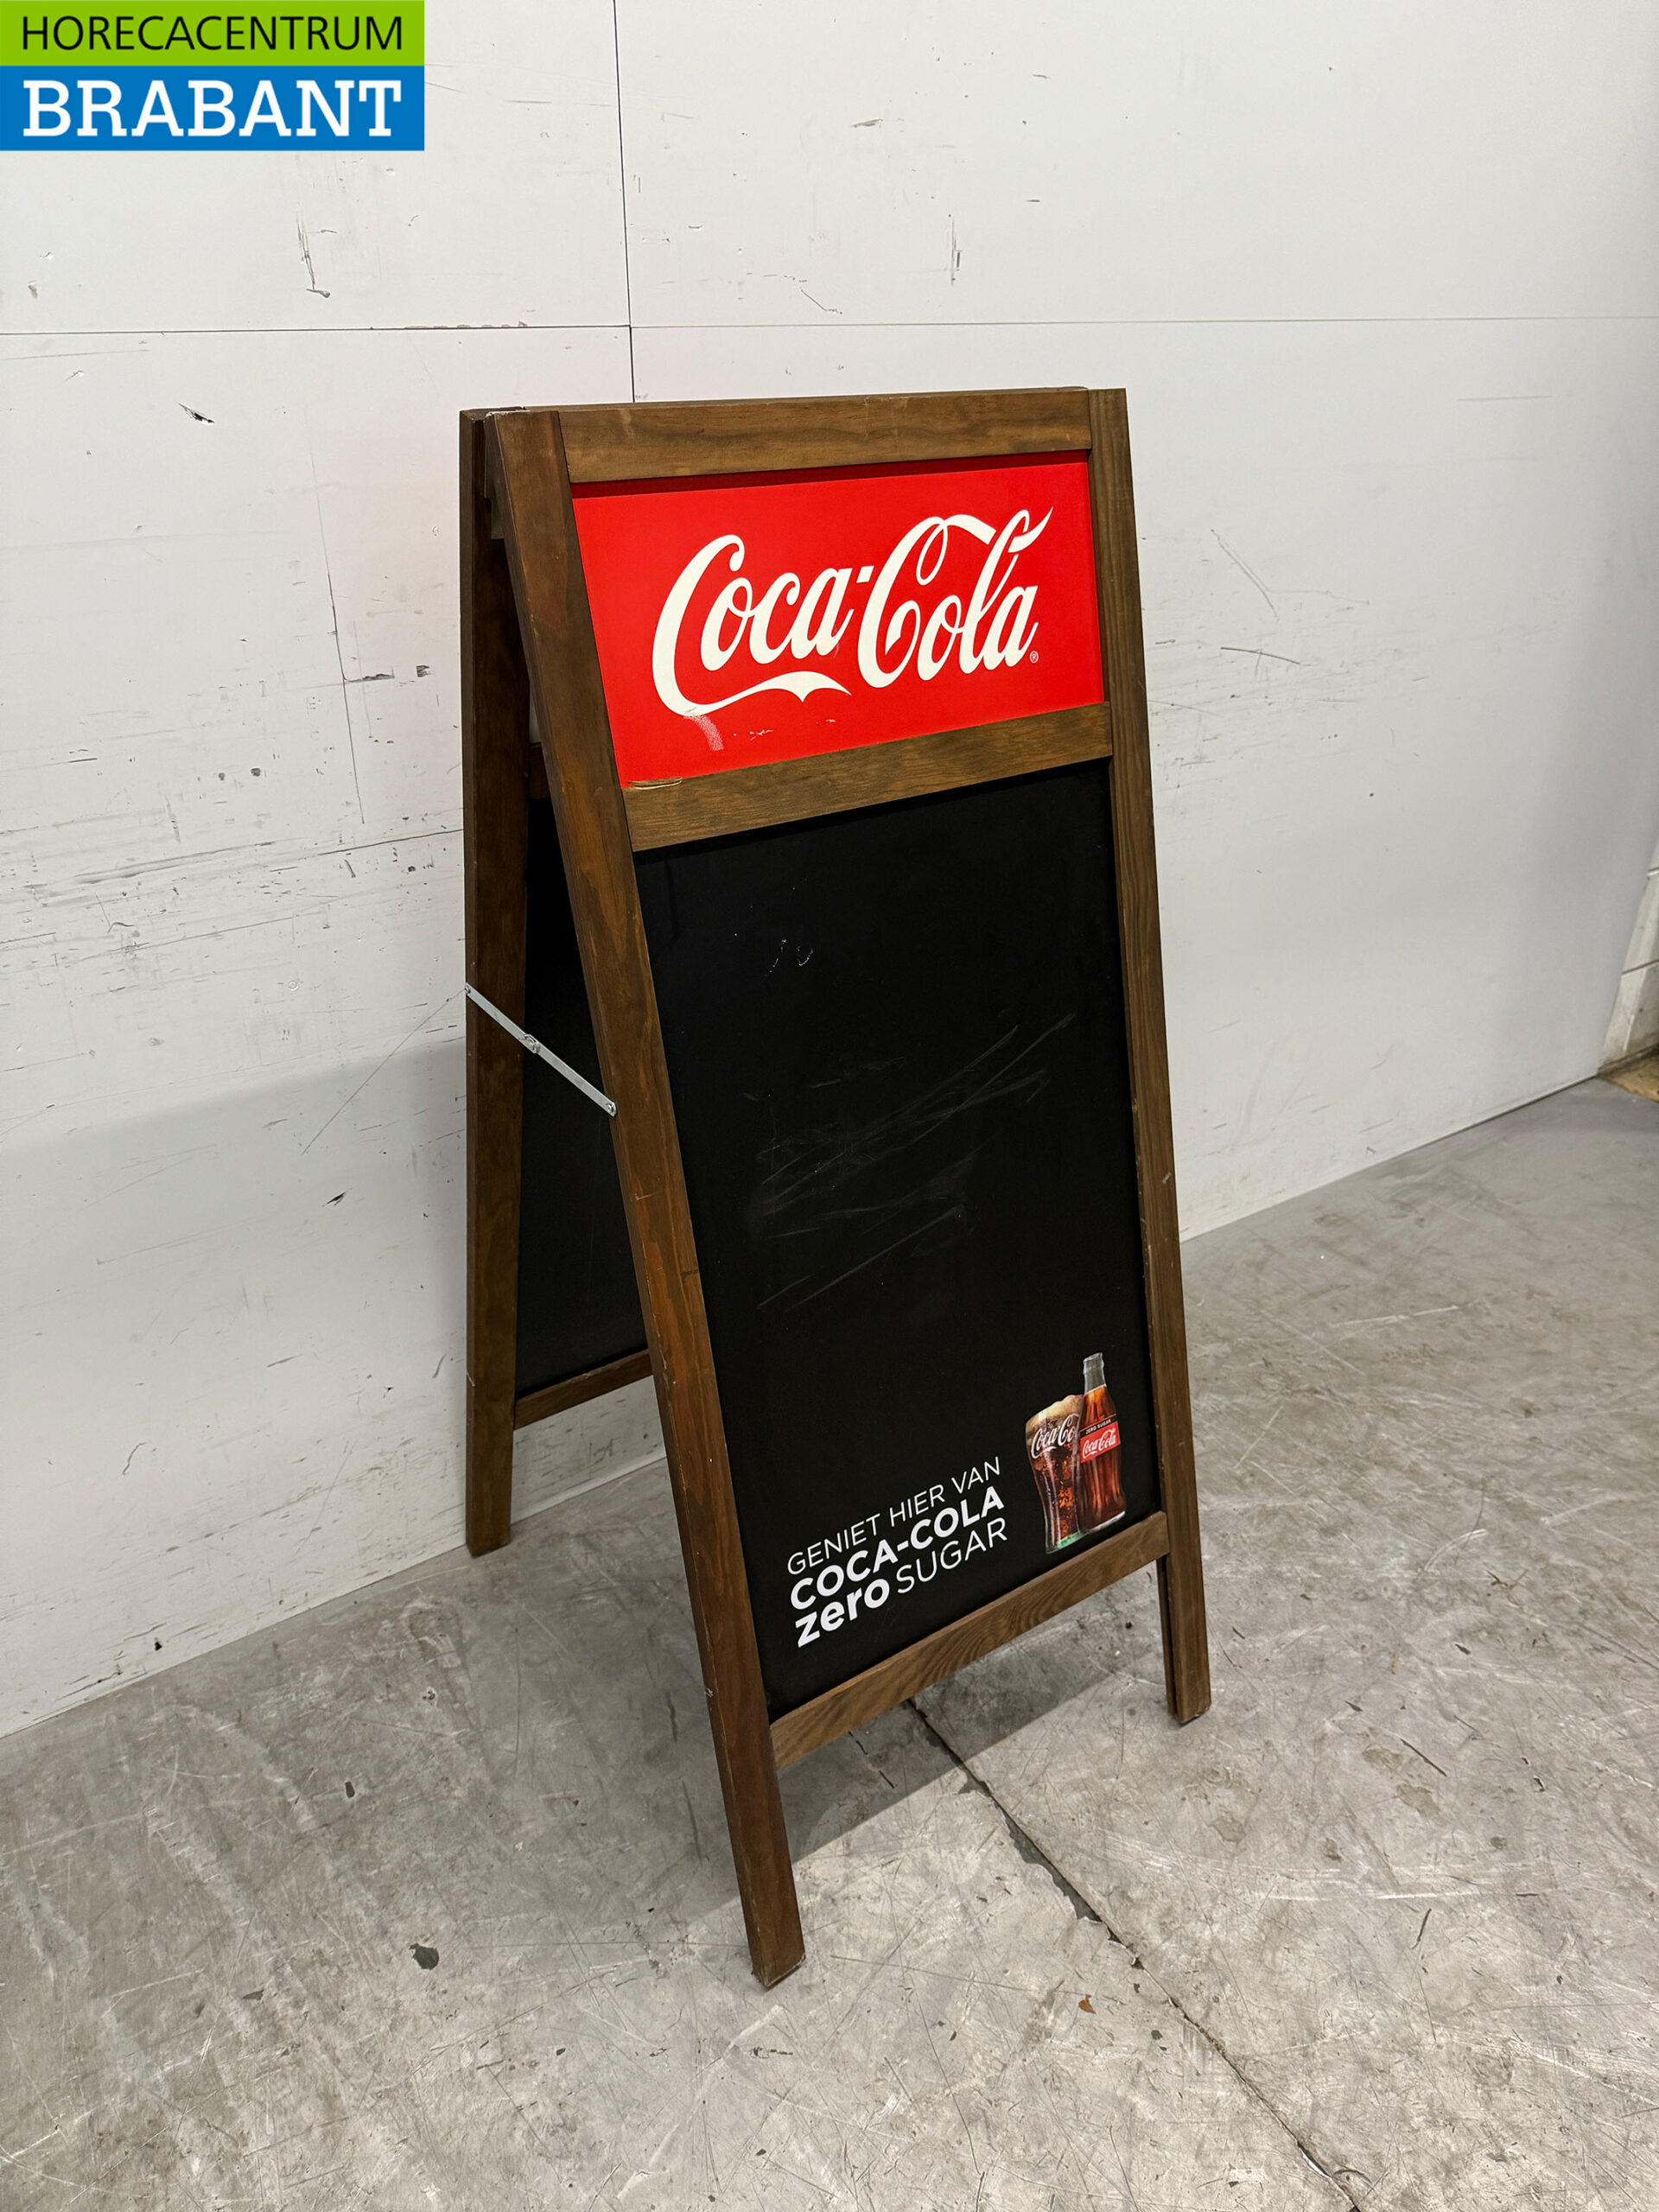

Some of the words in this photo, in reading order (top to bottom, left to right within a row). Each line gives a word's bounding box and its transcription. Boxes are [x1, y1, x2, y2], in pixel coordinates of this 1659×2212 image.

[652, 506, 1053, 717] Coca-Cola
[1085, 1426, 1096, 1434] ZERO
[787, 1513, 880, 1575] GENIET
[889, 1484, 945, 1527] HIER
[951, 1456, 1001, 1494] VAN
[790, 1485, 1005, 1611] COCA-COLA
[795, 1578, 891, 1648] zero
[895, 1516, 1008, 1594] SUGAR
